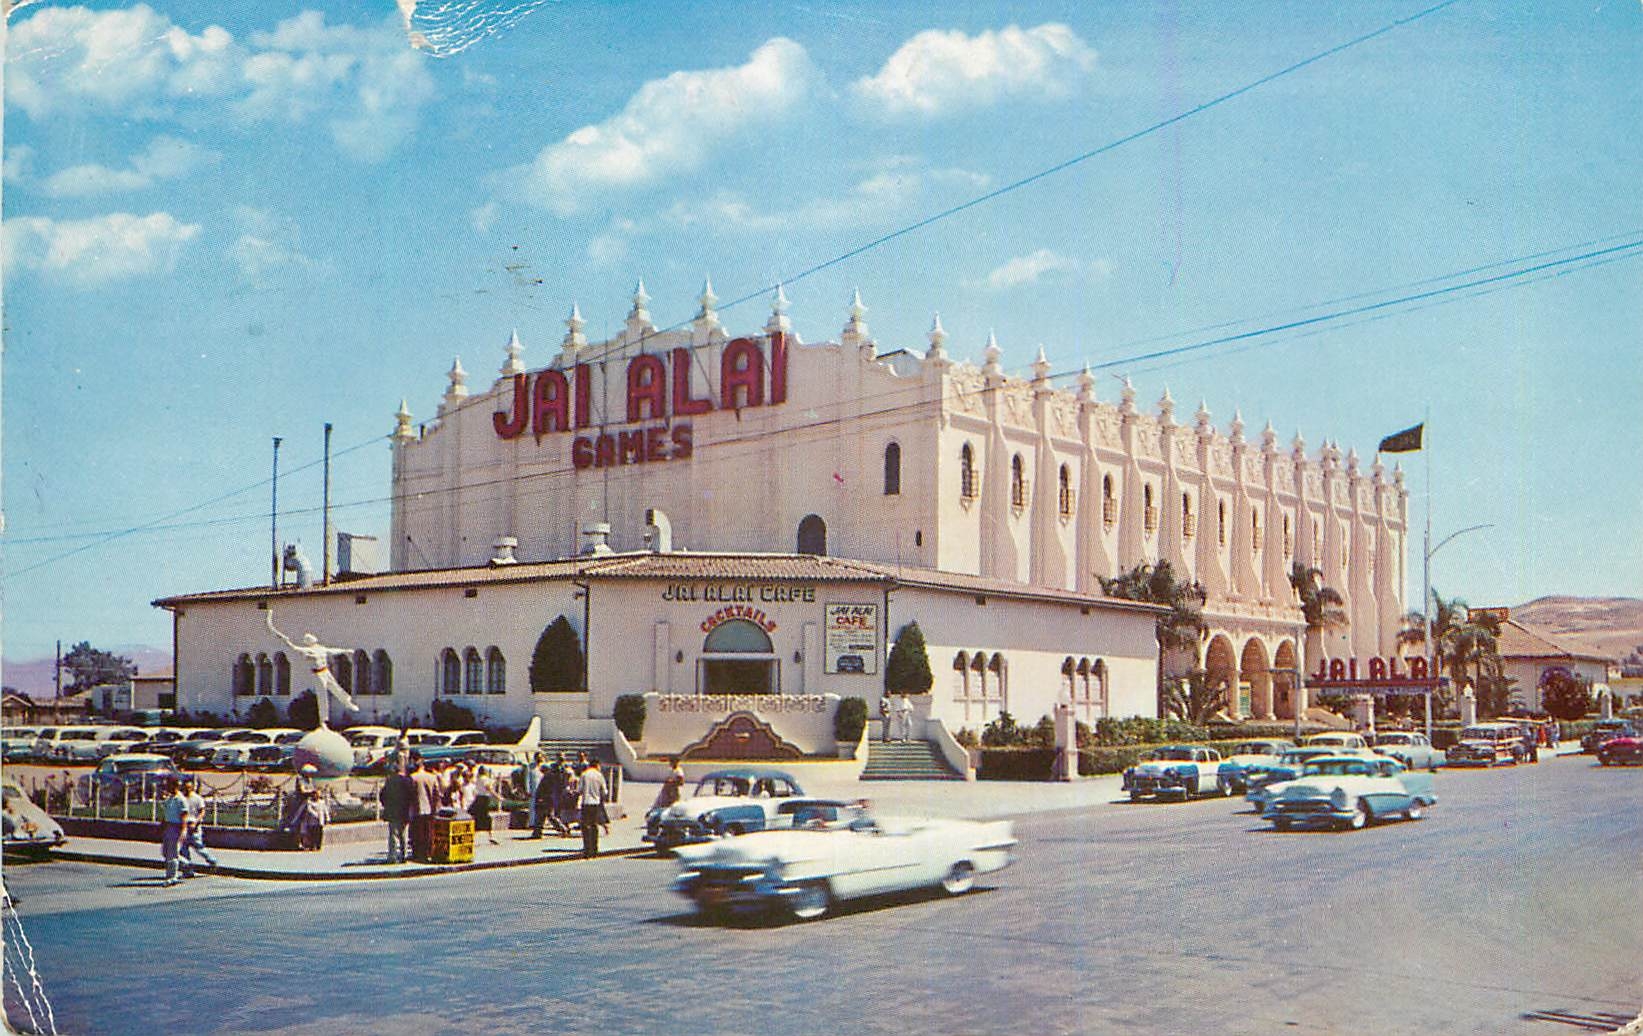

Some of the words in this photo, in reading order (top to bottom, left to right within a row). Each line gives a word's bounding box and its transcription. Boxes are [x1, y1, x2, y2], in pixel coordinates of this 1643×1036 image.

[493, 363, 590, 440] JAI
[627, 331, 788, 424] ALAI
[572, 425, 693, 469] GAMES
[662, 585, 696, 602] JAI
[704, 585, 753, 603] ALAI
[760, 585, 816, 603] CAFE
[1311, 657, 1358, 680] JAI
